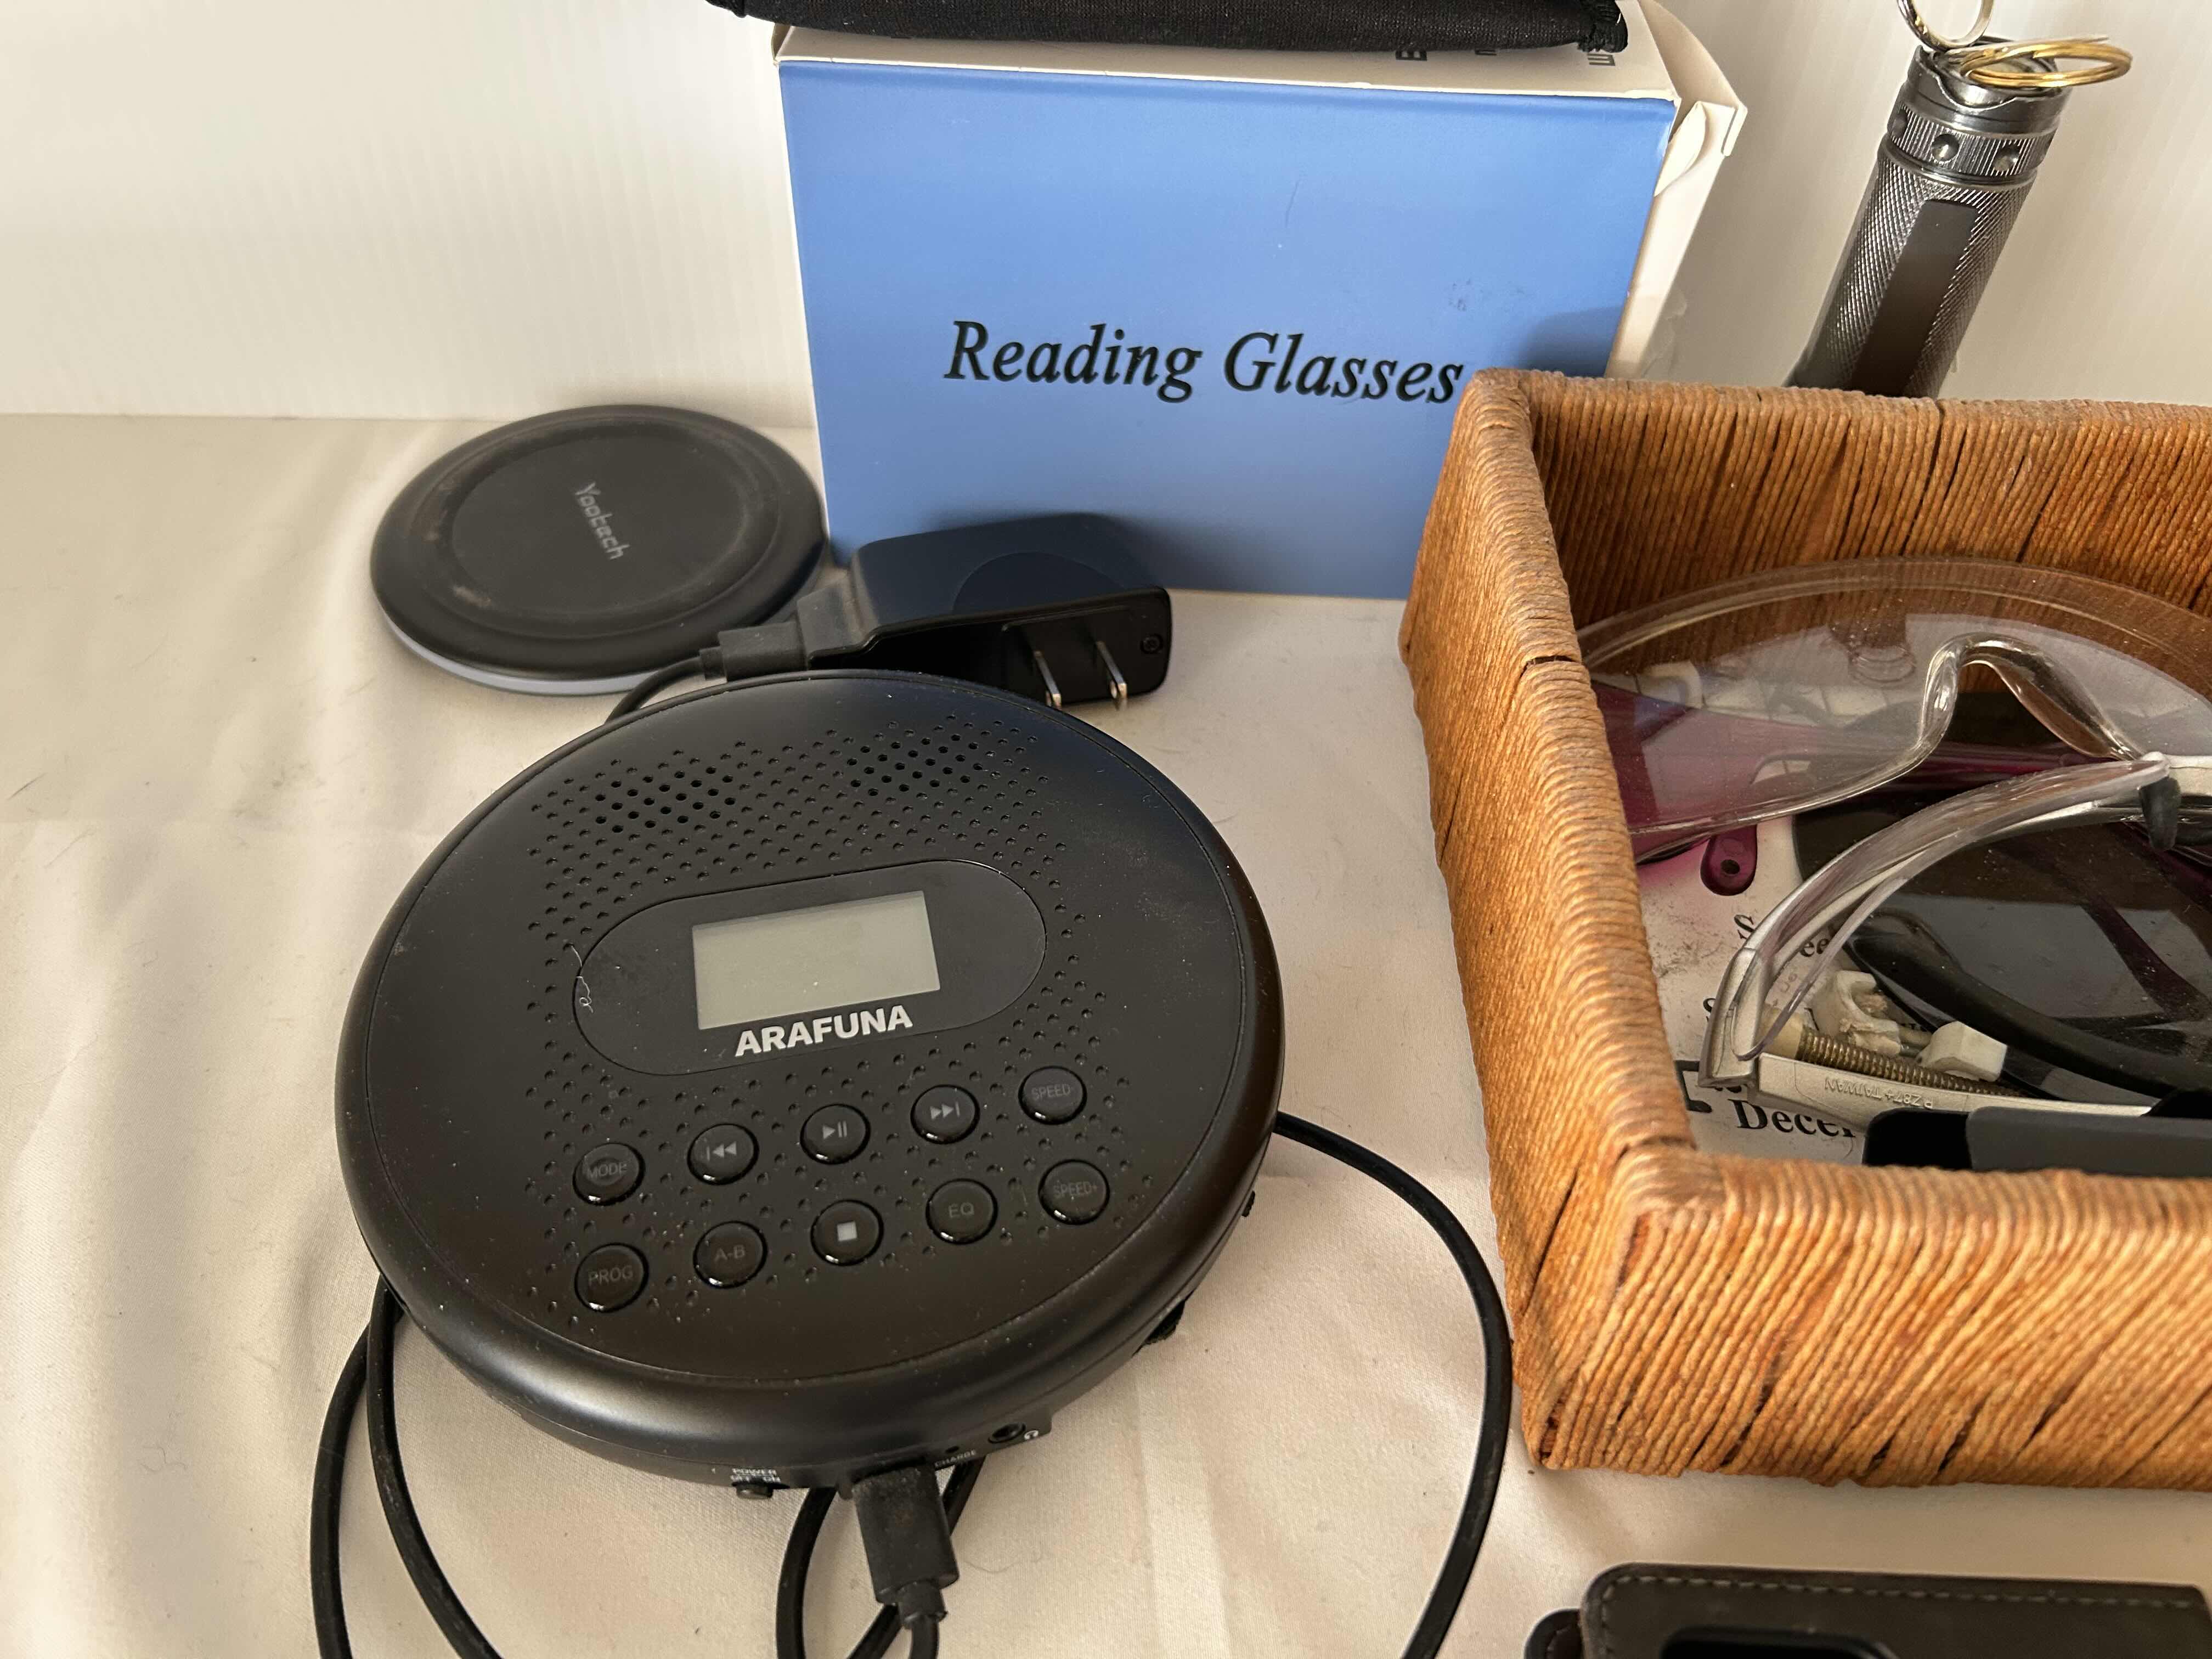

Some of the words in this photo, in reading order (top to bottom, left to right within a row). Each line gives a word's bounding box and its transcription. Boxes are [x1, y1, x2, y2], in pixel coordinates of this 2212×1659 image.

[944, 320, 1203, 403] Reading
[1223, 331, 1464, 404] Glasses
[575, 481, 630, 560] Yootech
[735, 1005, 913, 1057] ARAFUNA
[1825, 1076, 1882, 1100] TAIWAN
[586, 1161, 628, 1180] MODE
[949, 1202, 975, 1218] EQ
[715, 1244, 746, 1262] A-B
[588, 1265, 634, 1286] PROG
[732, 1468, 777, 1476] POWER
